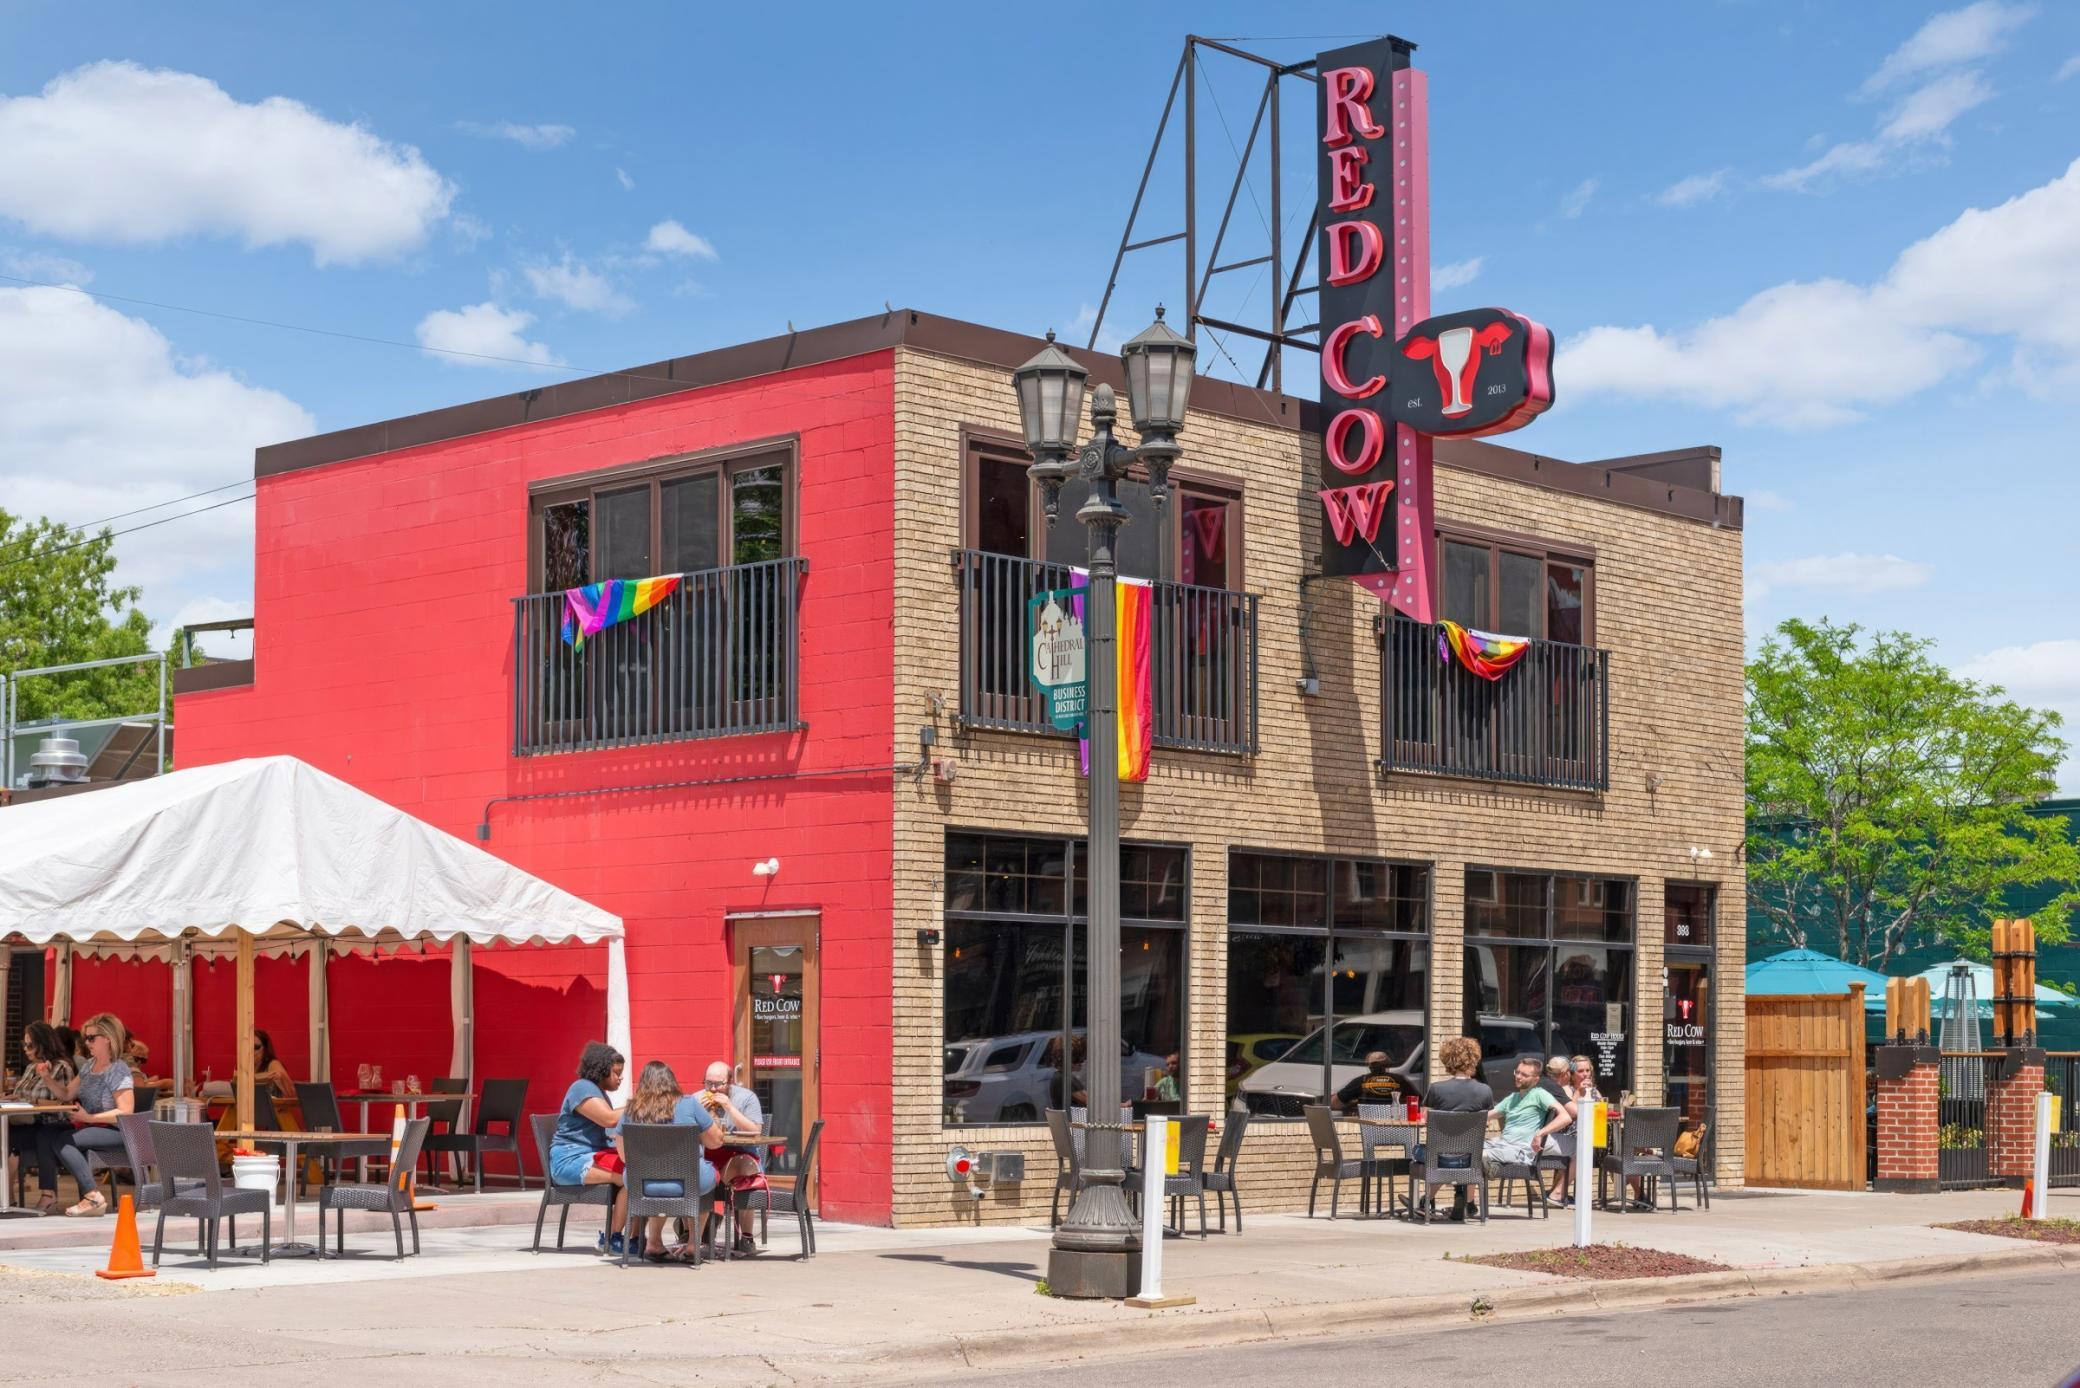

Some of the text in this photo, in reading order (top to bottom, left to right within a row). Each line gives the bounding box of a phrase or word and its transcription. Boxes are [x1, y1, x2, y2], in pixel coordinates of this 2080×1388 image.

[1318, 66, 1395, 547] RED COW
[1407, 384, 1507, 408] est. 2013
[1038, 638, 1084, 670] CATHEDRAL
[1051, 654, 1073, 680] HILL
[1053, 686, 1086, 701] BUSINESS
[1055, 699, 1085, 713] DISTRICT
[754, 998, 800, 1012] RED COW
[1667, 1024, 1704, 1038] RED COW
